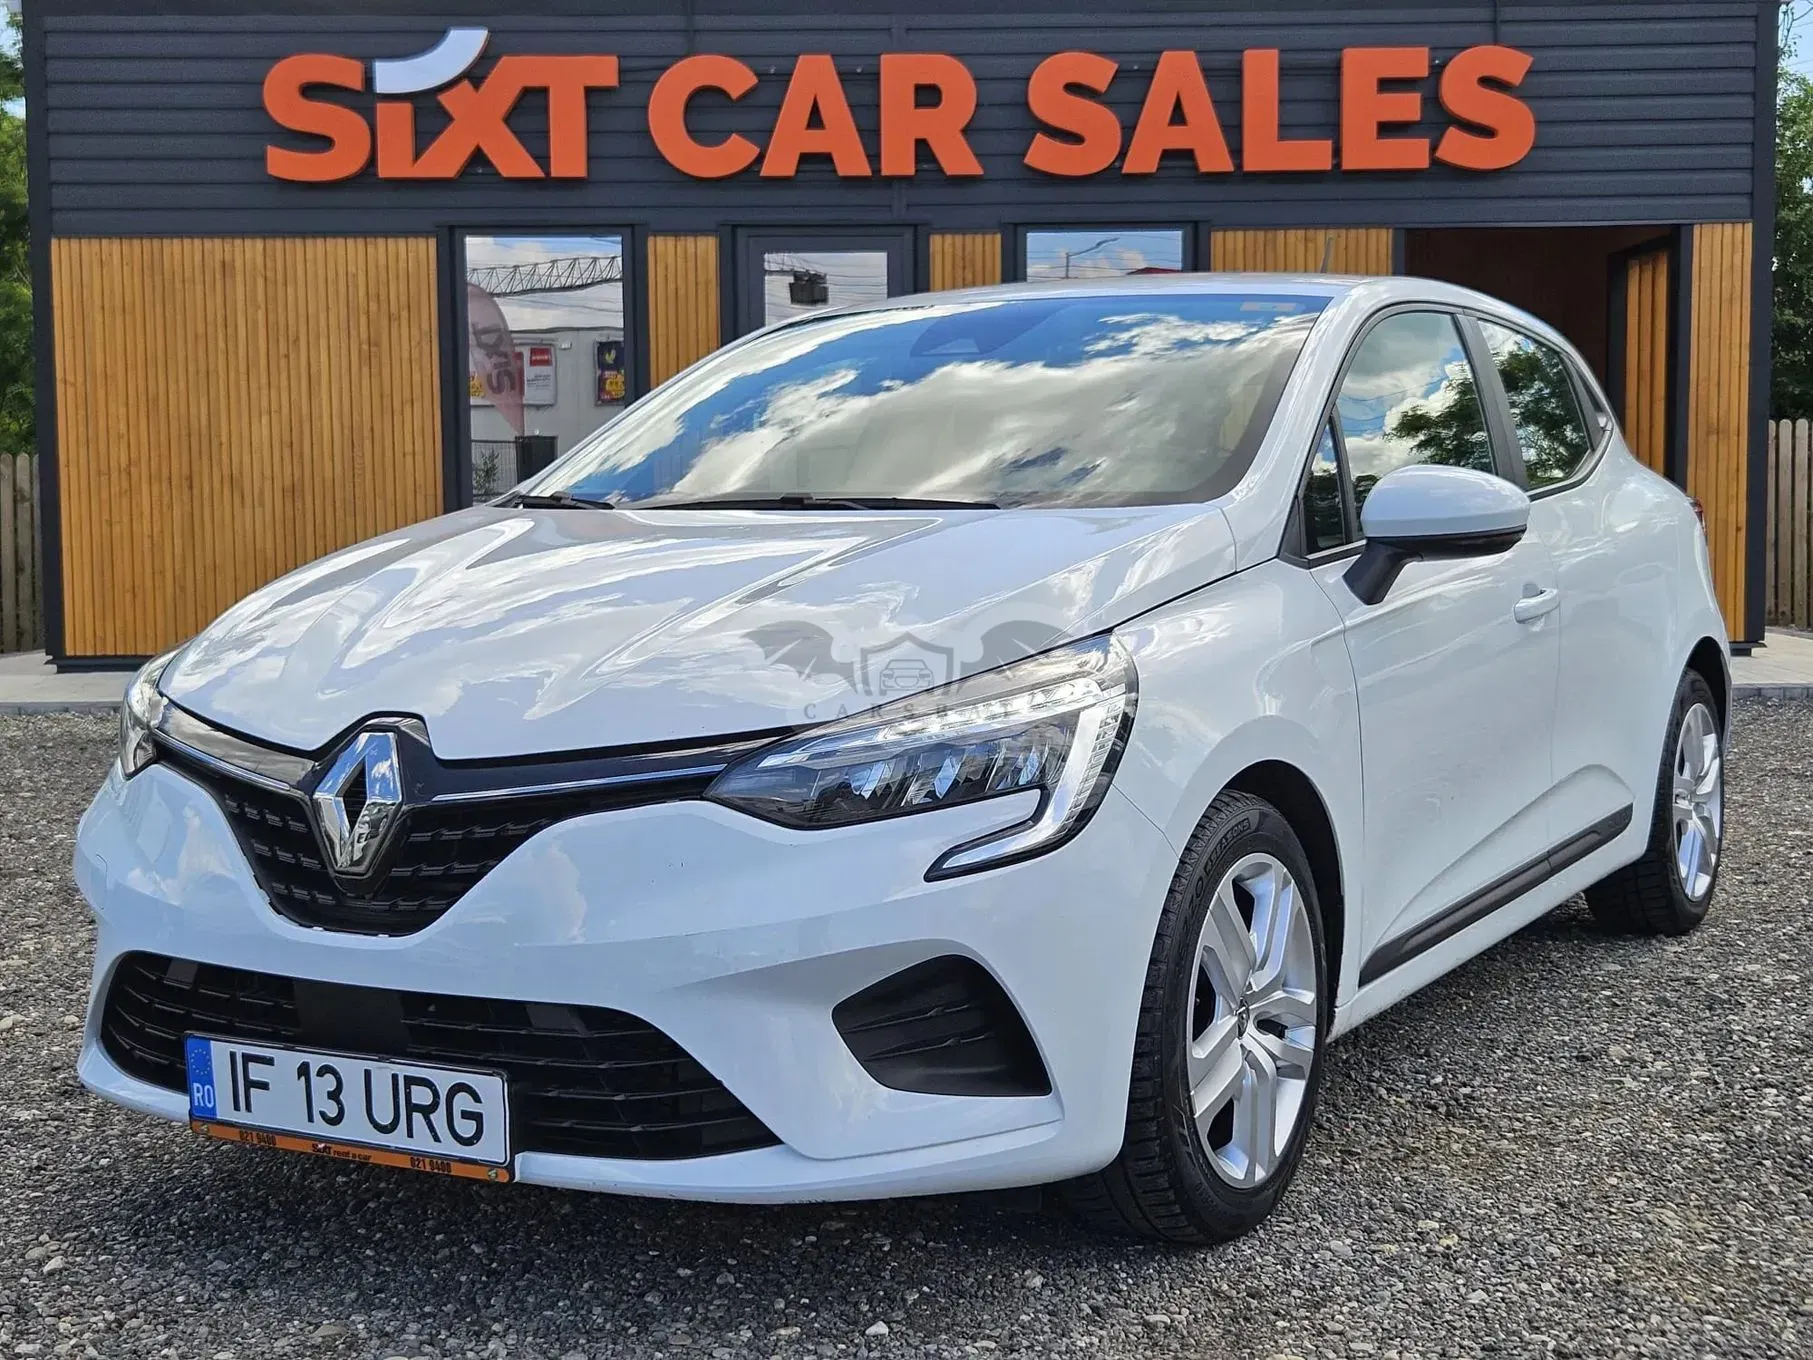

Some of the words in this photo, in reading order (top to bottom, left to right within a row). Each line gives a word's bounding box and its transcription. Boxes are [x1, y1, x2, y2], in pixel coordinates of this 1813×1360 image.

[648, 54, 985, 178] CAR
[1023, 45, 1536, 177] SALES
[193, 1083, 215, 1109] RO
[229, 1050, 275, 1113] IF
[297, 1061, 346, 1127] 13
[364, 1068, 485, 1147] URG
[410, 1156, 427, 1170] 021
